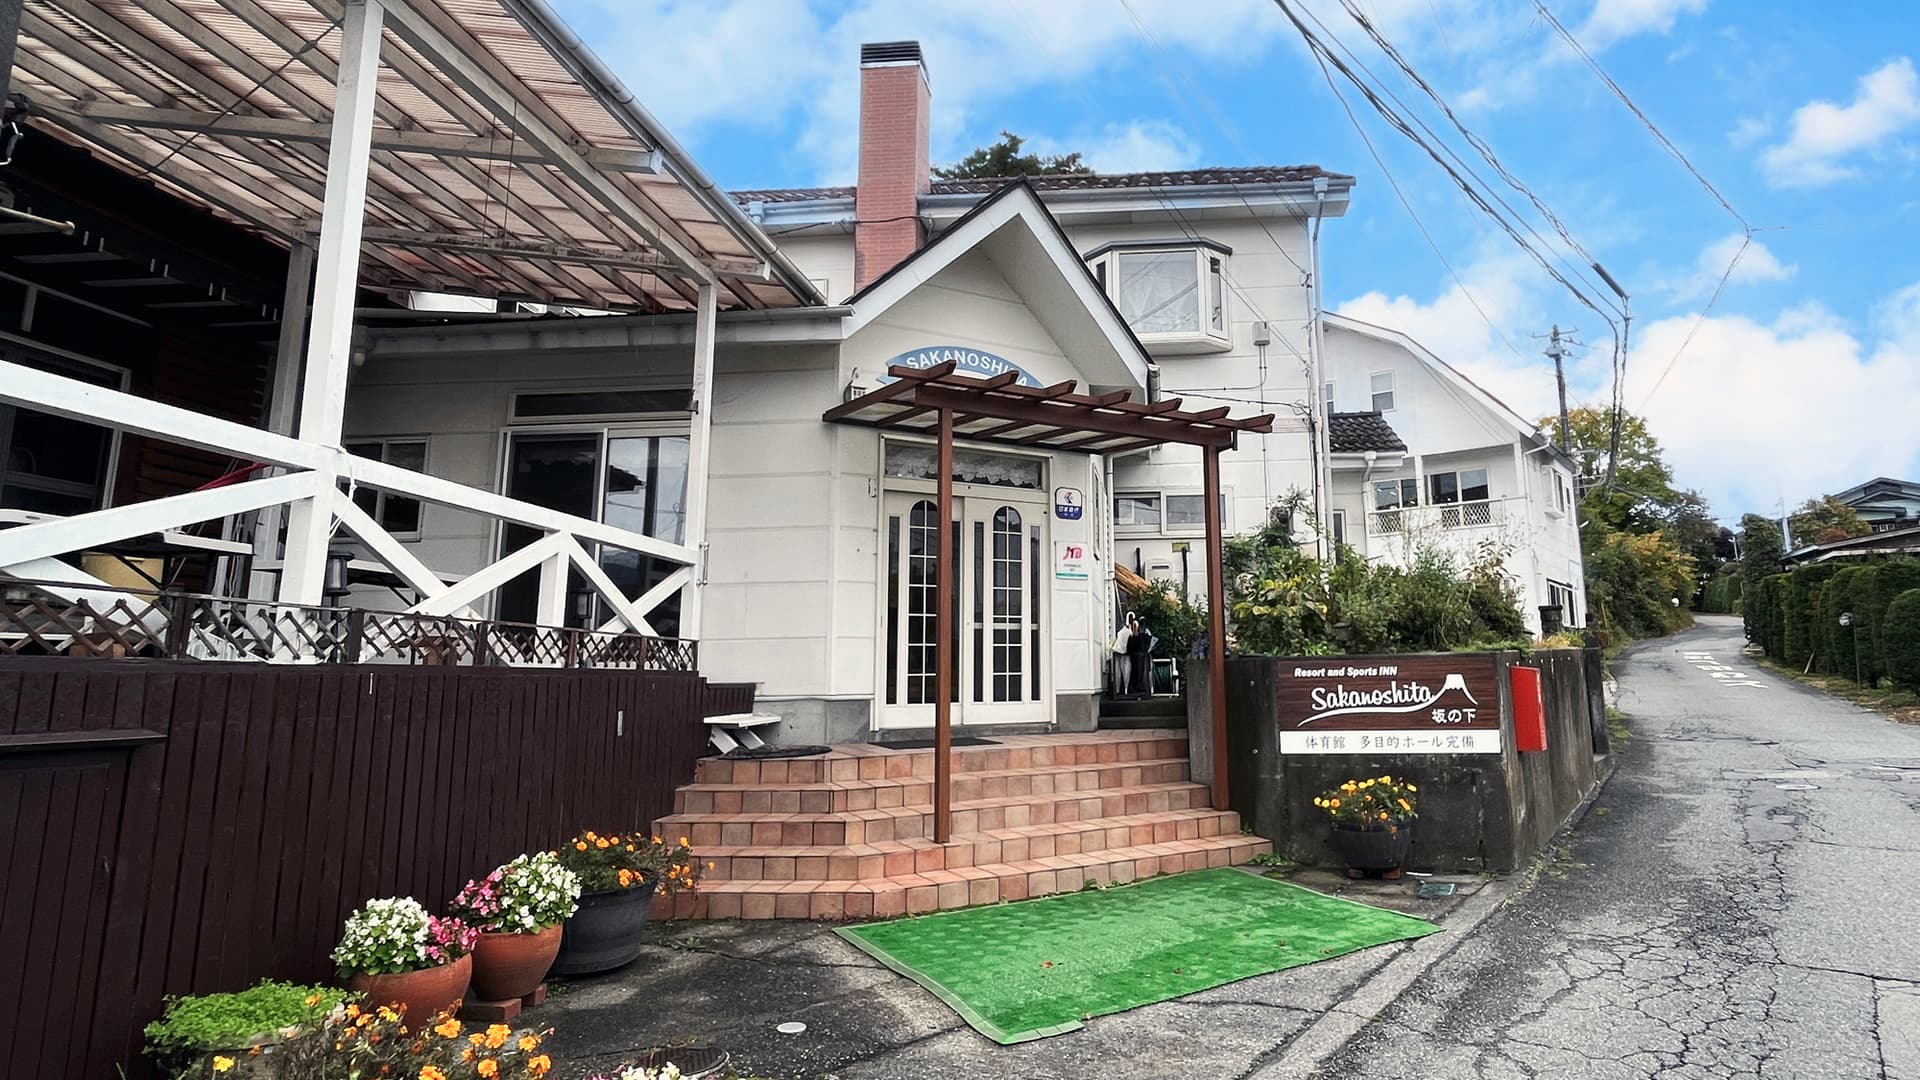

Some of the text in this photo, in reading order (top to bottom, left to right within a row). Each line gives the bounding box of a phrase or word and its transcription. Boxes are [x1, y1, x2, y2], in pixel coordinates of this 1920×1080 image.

[906, 350, 1028, 386] SAKANOSHIA
[1063, 546, 1082, 560] JTB
[1294, 666, 1398, 678] Resort and Sports INN
[1311, 680, 1433, 711] Sakanoshita
[1431, 708, 1477, 724] 坂の下
[1305, 735, 1346, 749] 体育館
